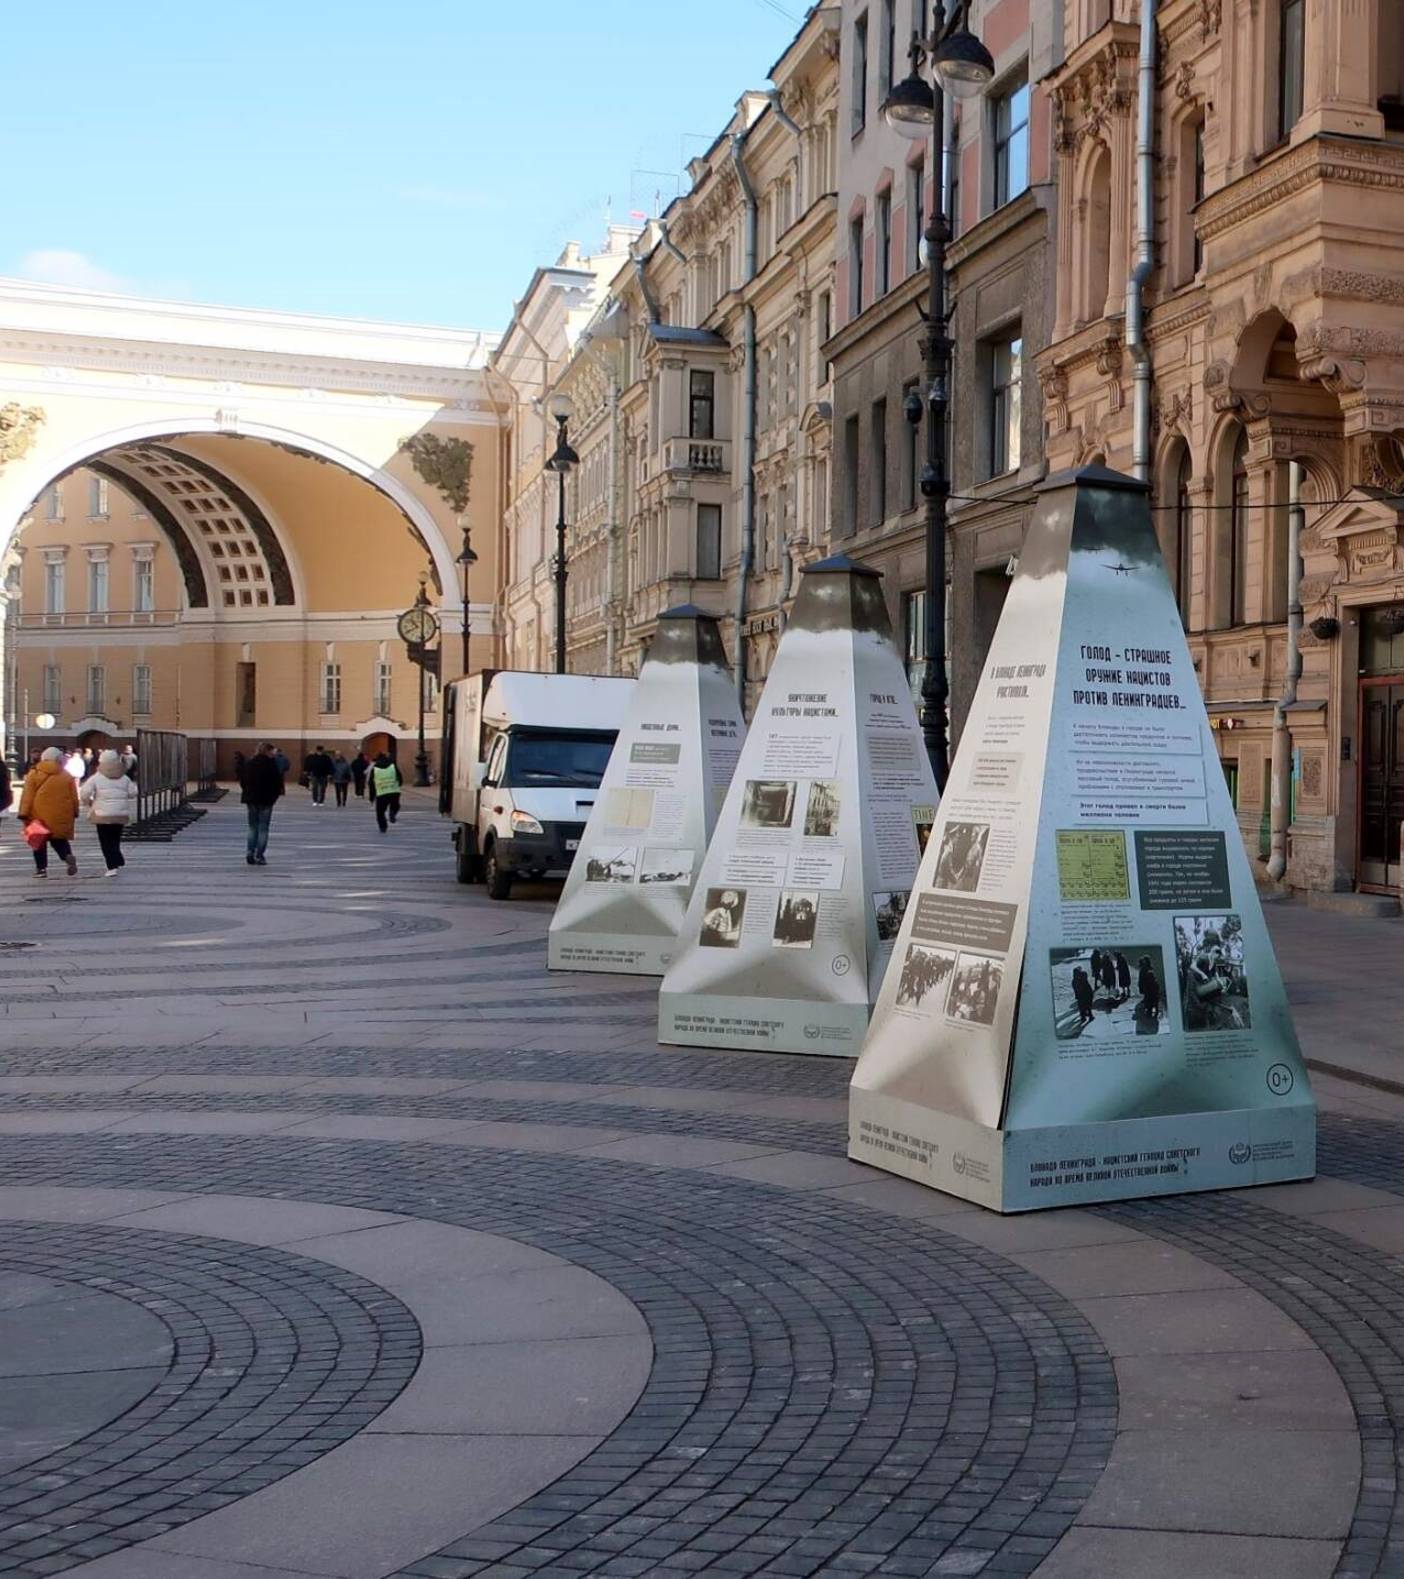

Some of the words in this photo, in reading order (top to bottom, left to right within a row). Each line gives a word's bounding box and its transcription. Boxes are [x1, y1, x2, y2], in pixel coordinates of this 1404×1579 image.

[1081, 646, 1111, 662] ГОЛОД
[1124, 648, 1171, 664] СТРАШНОЕ
[1086, 668, 1122, 683] ОРУЖИЕ
[1127, 671, 1171, 686] НАЦИСТОВ
[1073, 691, 1107, 705] ПРОТИВ
